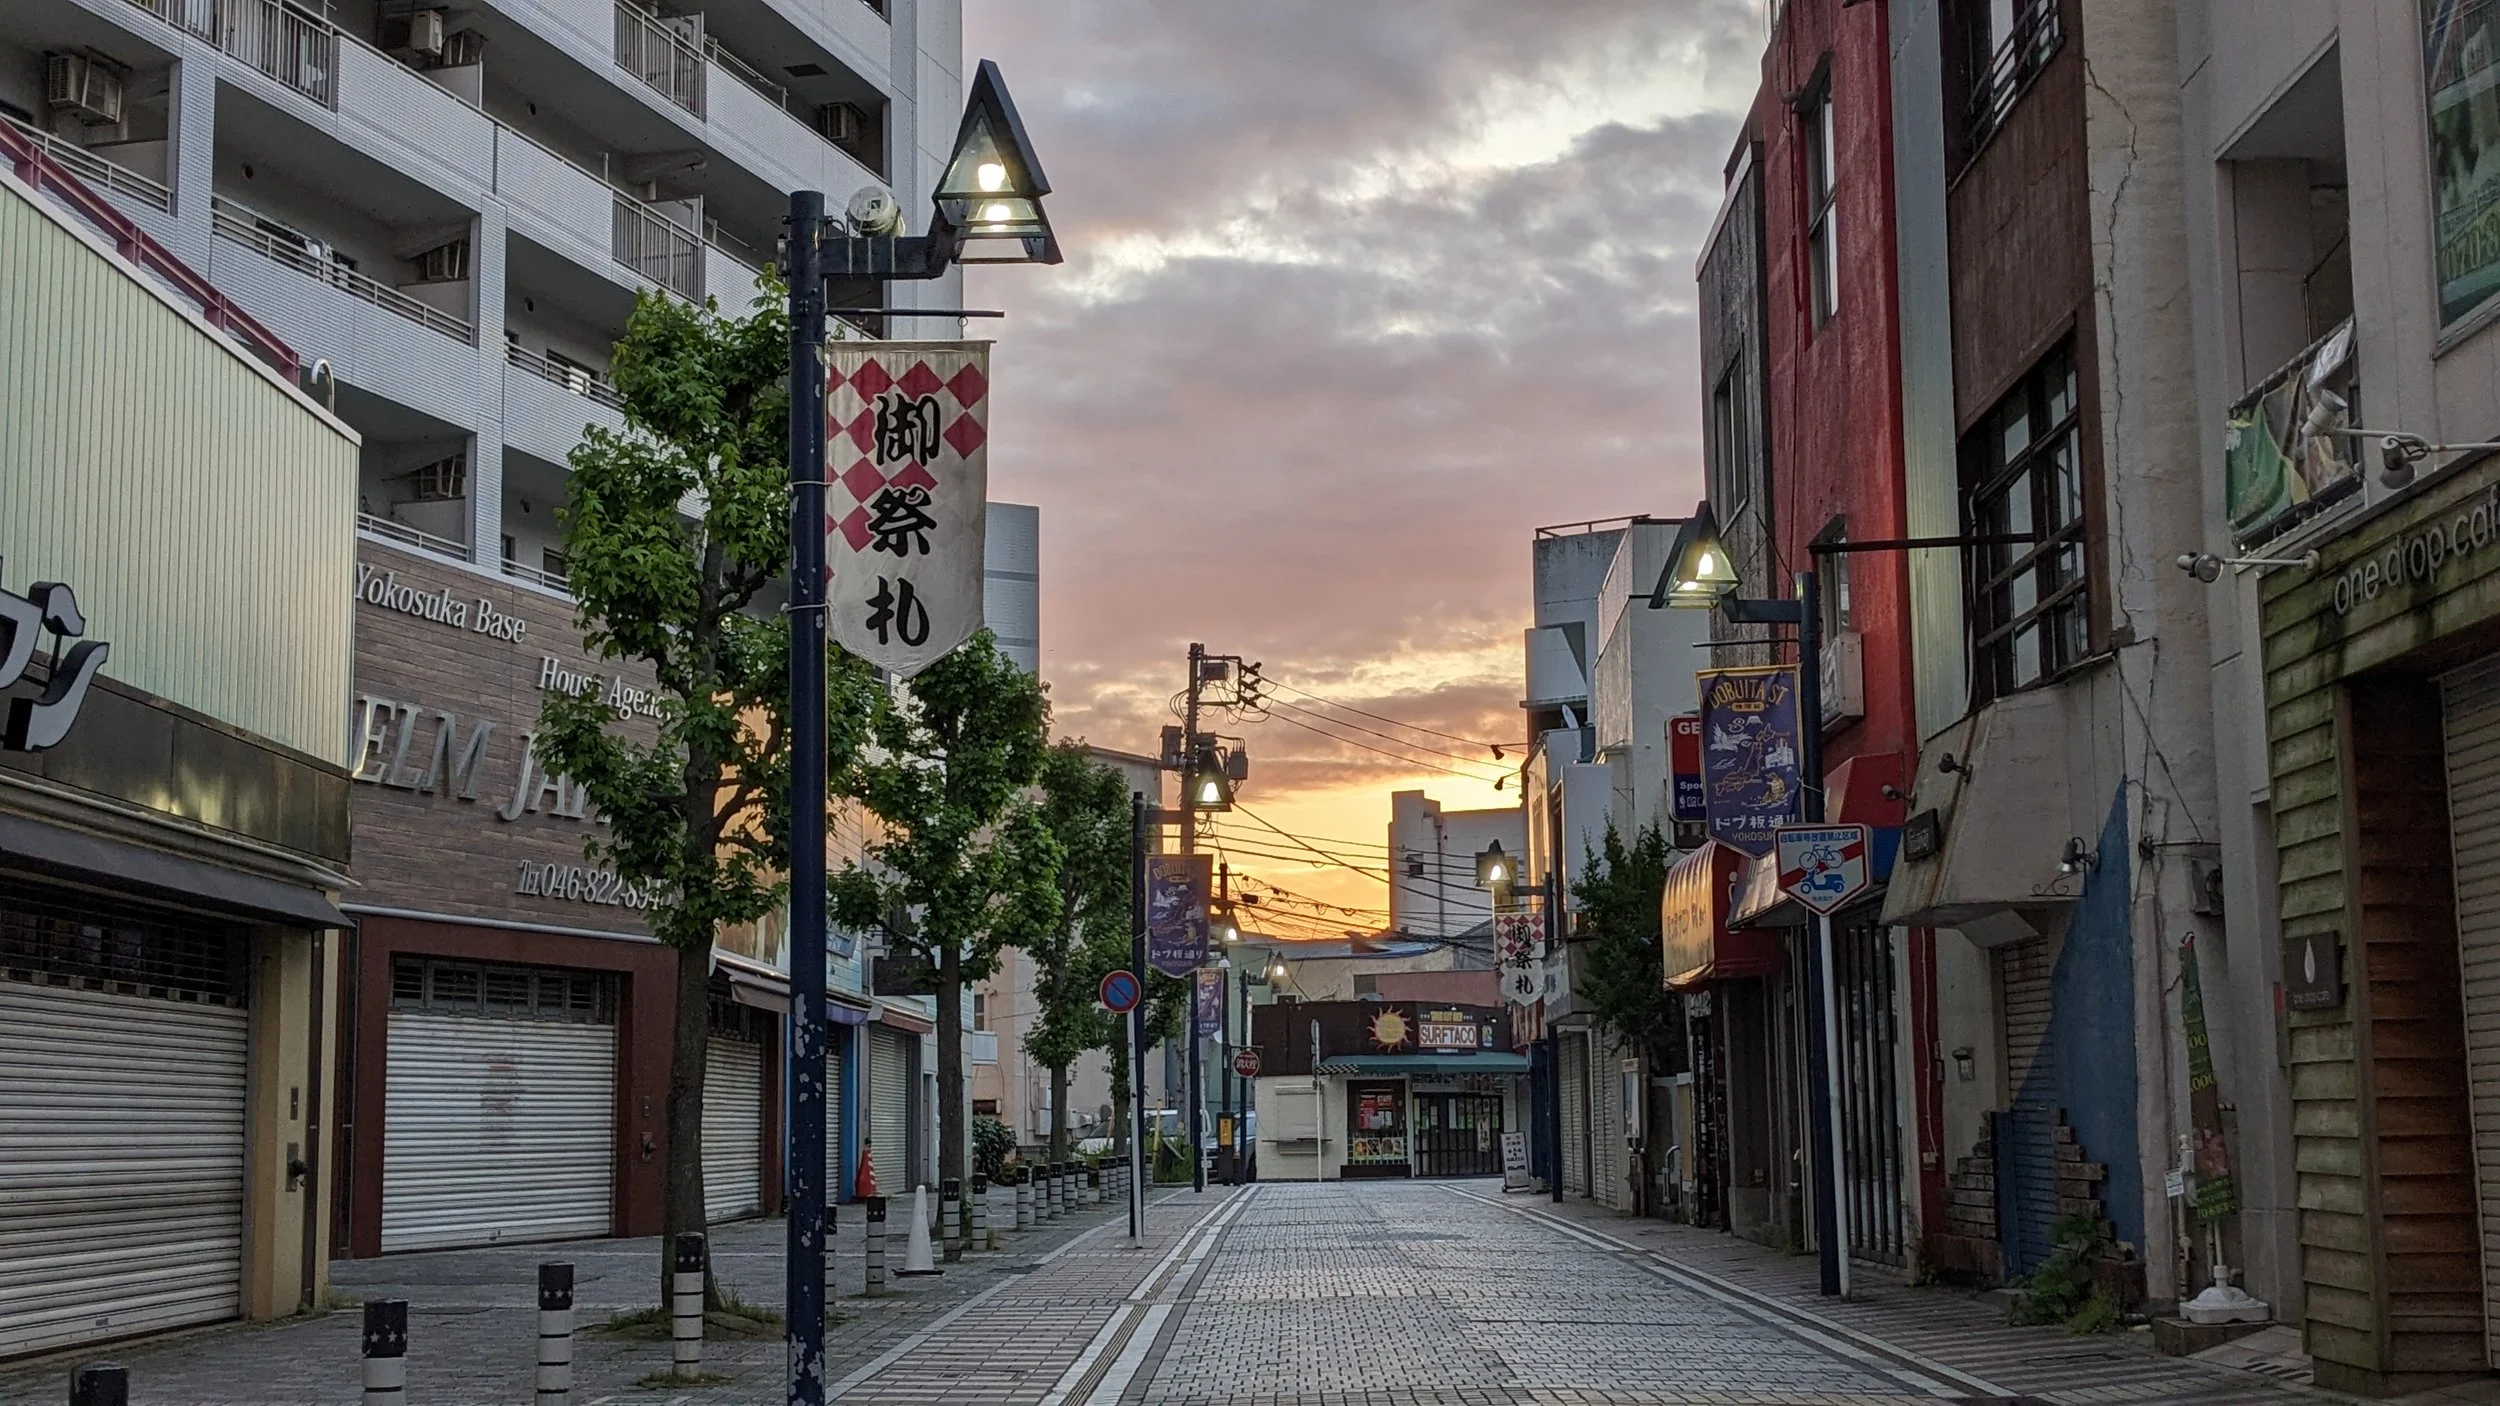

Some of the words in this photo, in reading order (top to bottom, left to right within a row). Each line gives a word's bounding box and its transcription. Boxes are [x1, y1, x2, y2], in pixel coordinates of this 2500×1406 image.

[2335, 560, 2380, 616] one
[2385, 534, 2445, 585] drop
[2453, 484, 2500, 557] caf
[355, 562, 466, 628] Yokosuka
[473, 598, 527, 644] Base
[607, 674, 671, 721] Agenc
[1709, 679, 1765, 710] DOBUITA
[1768, 684, 1789, 705] ST
[352, 695, 496, 800] ELM
[1680, 781, 1703, 792] Spo
[1732, 831, 1774, 841] YOKOSUK
